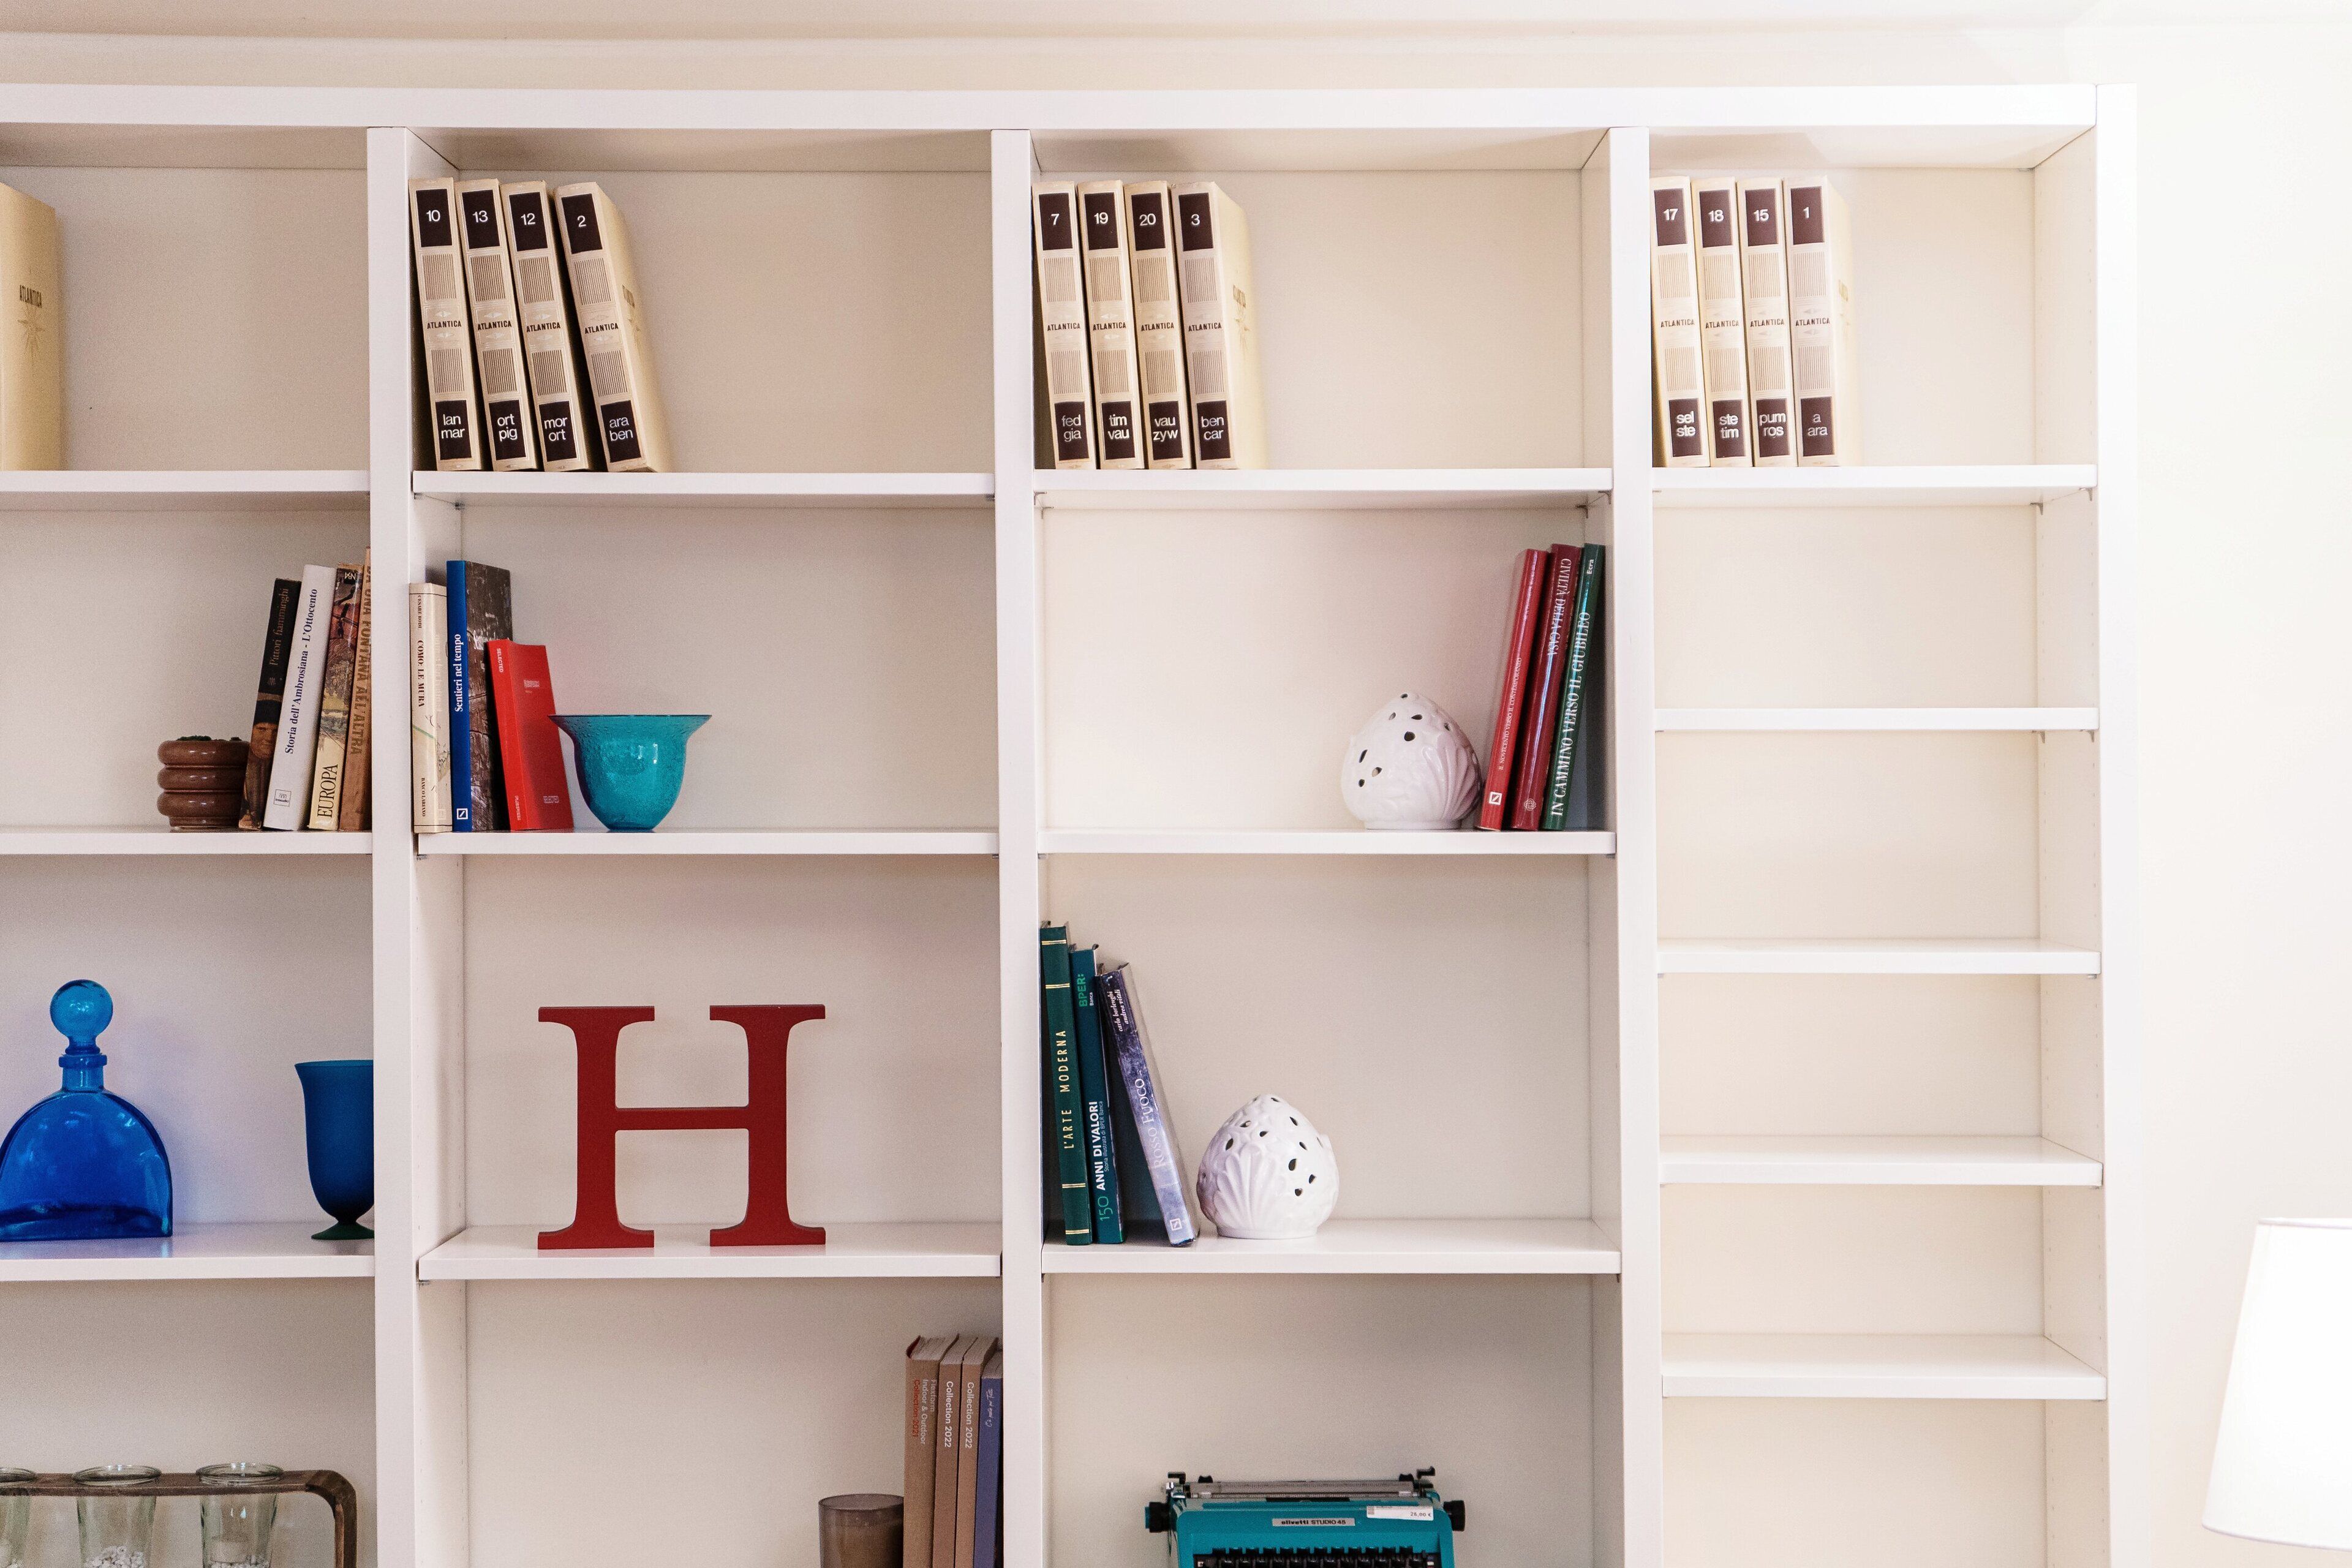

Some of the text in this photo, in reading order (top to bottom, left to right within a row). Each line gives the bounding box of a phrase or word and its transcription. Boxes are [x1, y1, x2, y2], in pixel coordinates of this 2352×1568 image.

[426, 210, 440, 222] 10
[473, 211, 488, 222] 13
[1094, 213, 1108, 224] 19
[1663, 209, 1678, 221] 17
[1708, 209, 1724, 222] 18
[1753, 209, 1769, 222] 15
[1803, 208, 1809, 218] 1
[521, 214, 535, 225] 12
[577, 216, 586, 227] 2
[1050, 214, 1060, 225] 7
[1139, 214, 1156, 226] 20
[1191, 214, 1200, 225] 3
[19, 285, 43, 309] ATLANTICA
[478, 320, 512, 331] ATLANTICA
[527, 322, 560, 332] ATLANTICA
[1047, 322, 1080, 331] ATLANTICA
[1093, 322, 1126, 331] ATLANTICA
[1141, 322, 1174, 331] ATLANTICA
[1188, 323, 1222, 332] ATLANTICA
[1660, 318, 1695, 328] ATLANTICA
[1705, 320, 1740, 329] ATLANTICA
[1750, 318, 1784, 328] ATLANTICA
[1795, 317, 1830, 326] ATLANTICA
[584, 323, 619, 334] ATLANTICA
[443, 415, 461, 425] lan
[497, 414, 514, 426] ort
[545, 416, 567, 428] mor
[609, 417, 629, 428] ara
[1061, 415, 1081, 427] fed
[1109, 415, 1128, 426] tim
[1154, 416, 1176, 427] vau
[1201, 415, 1224, 428] ben
[1676, 412, 1694, 423] sel
[1719, 413, 1738, 425] ste
[1759, 412, 1785, 426] pum
[1812, 413, 1821, 423] a
[441, 427, 464, 439] mar
[499, 427, 518, 442] pig
[549, 429, 566, 442] ort
[610, 428, 633, 441] ben
[1064, 428, 1082, 442] gia
[1108, 428, 1129, 439] vau
[1153, 429, 1178, 442] zyw
[1204, 429, 1223, 440] car
[1676, 425, 1695, 436] ste
[1721, 426, 1739, 438] tim
[1763, 425, 1784, 436] ros
[1808, 424, 1828, 436] ara
[1547, 559, 1572, 655] CIVILTÀ DELLA CASA
[270, 588, 289, 666] Pittori fiamminghi
[285, 727, 297, 754] Storia
[302, 589, 318, 641] L'Ottocento
[418, 669, 424, 680] LE
[453, 634, 464, 712] Sentieri nel tempo
[1551, 612, 1591, 816] IN CAMMINO VERSO IL GIUBILEO
[1501, 731, 1510, 764] NOVECENTO
[317, 764, 338, 818] EUROPA
[1107, 991, 1123, 1032] carlo borlenghi
[1115, 989, 1129, 1024] andrea vitali
[1055, 1030, 1074, 1149] L'ARTE MODERNA
[538, 1004, 826, 1250] H
[1089, 1101, 1114, 1221] 150 ANNI DI VALORI
